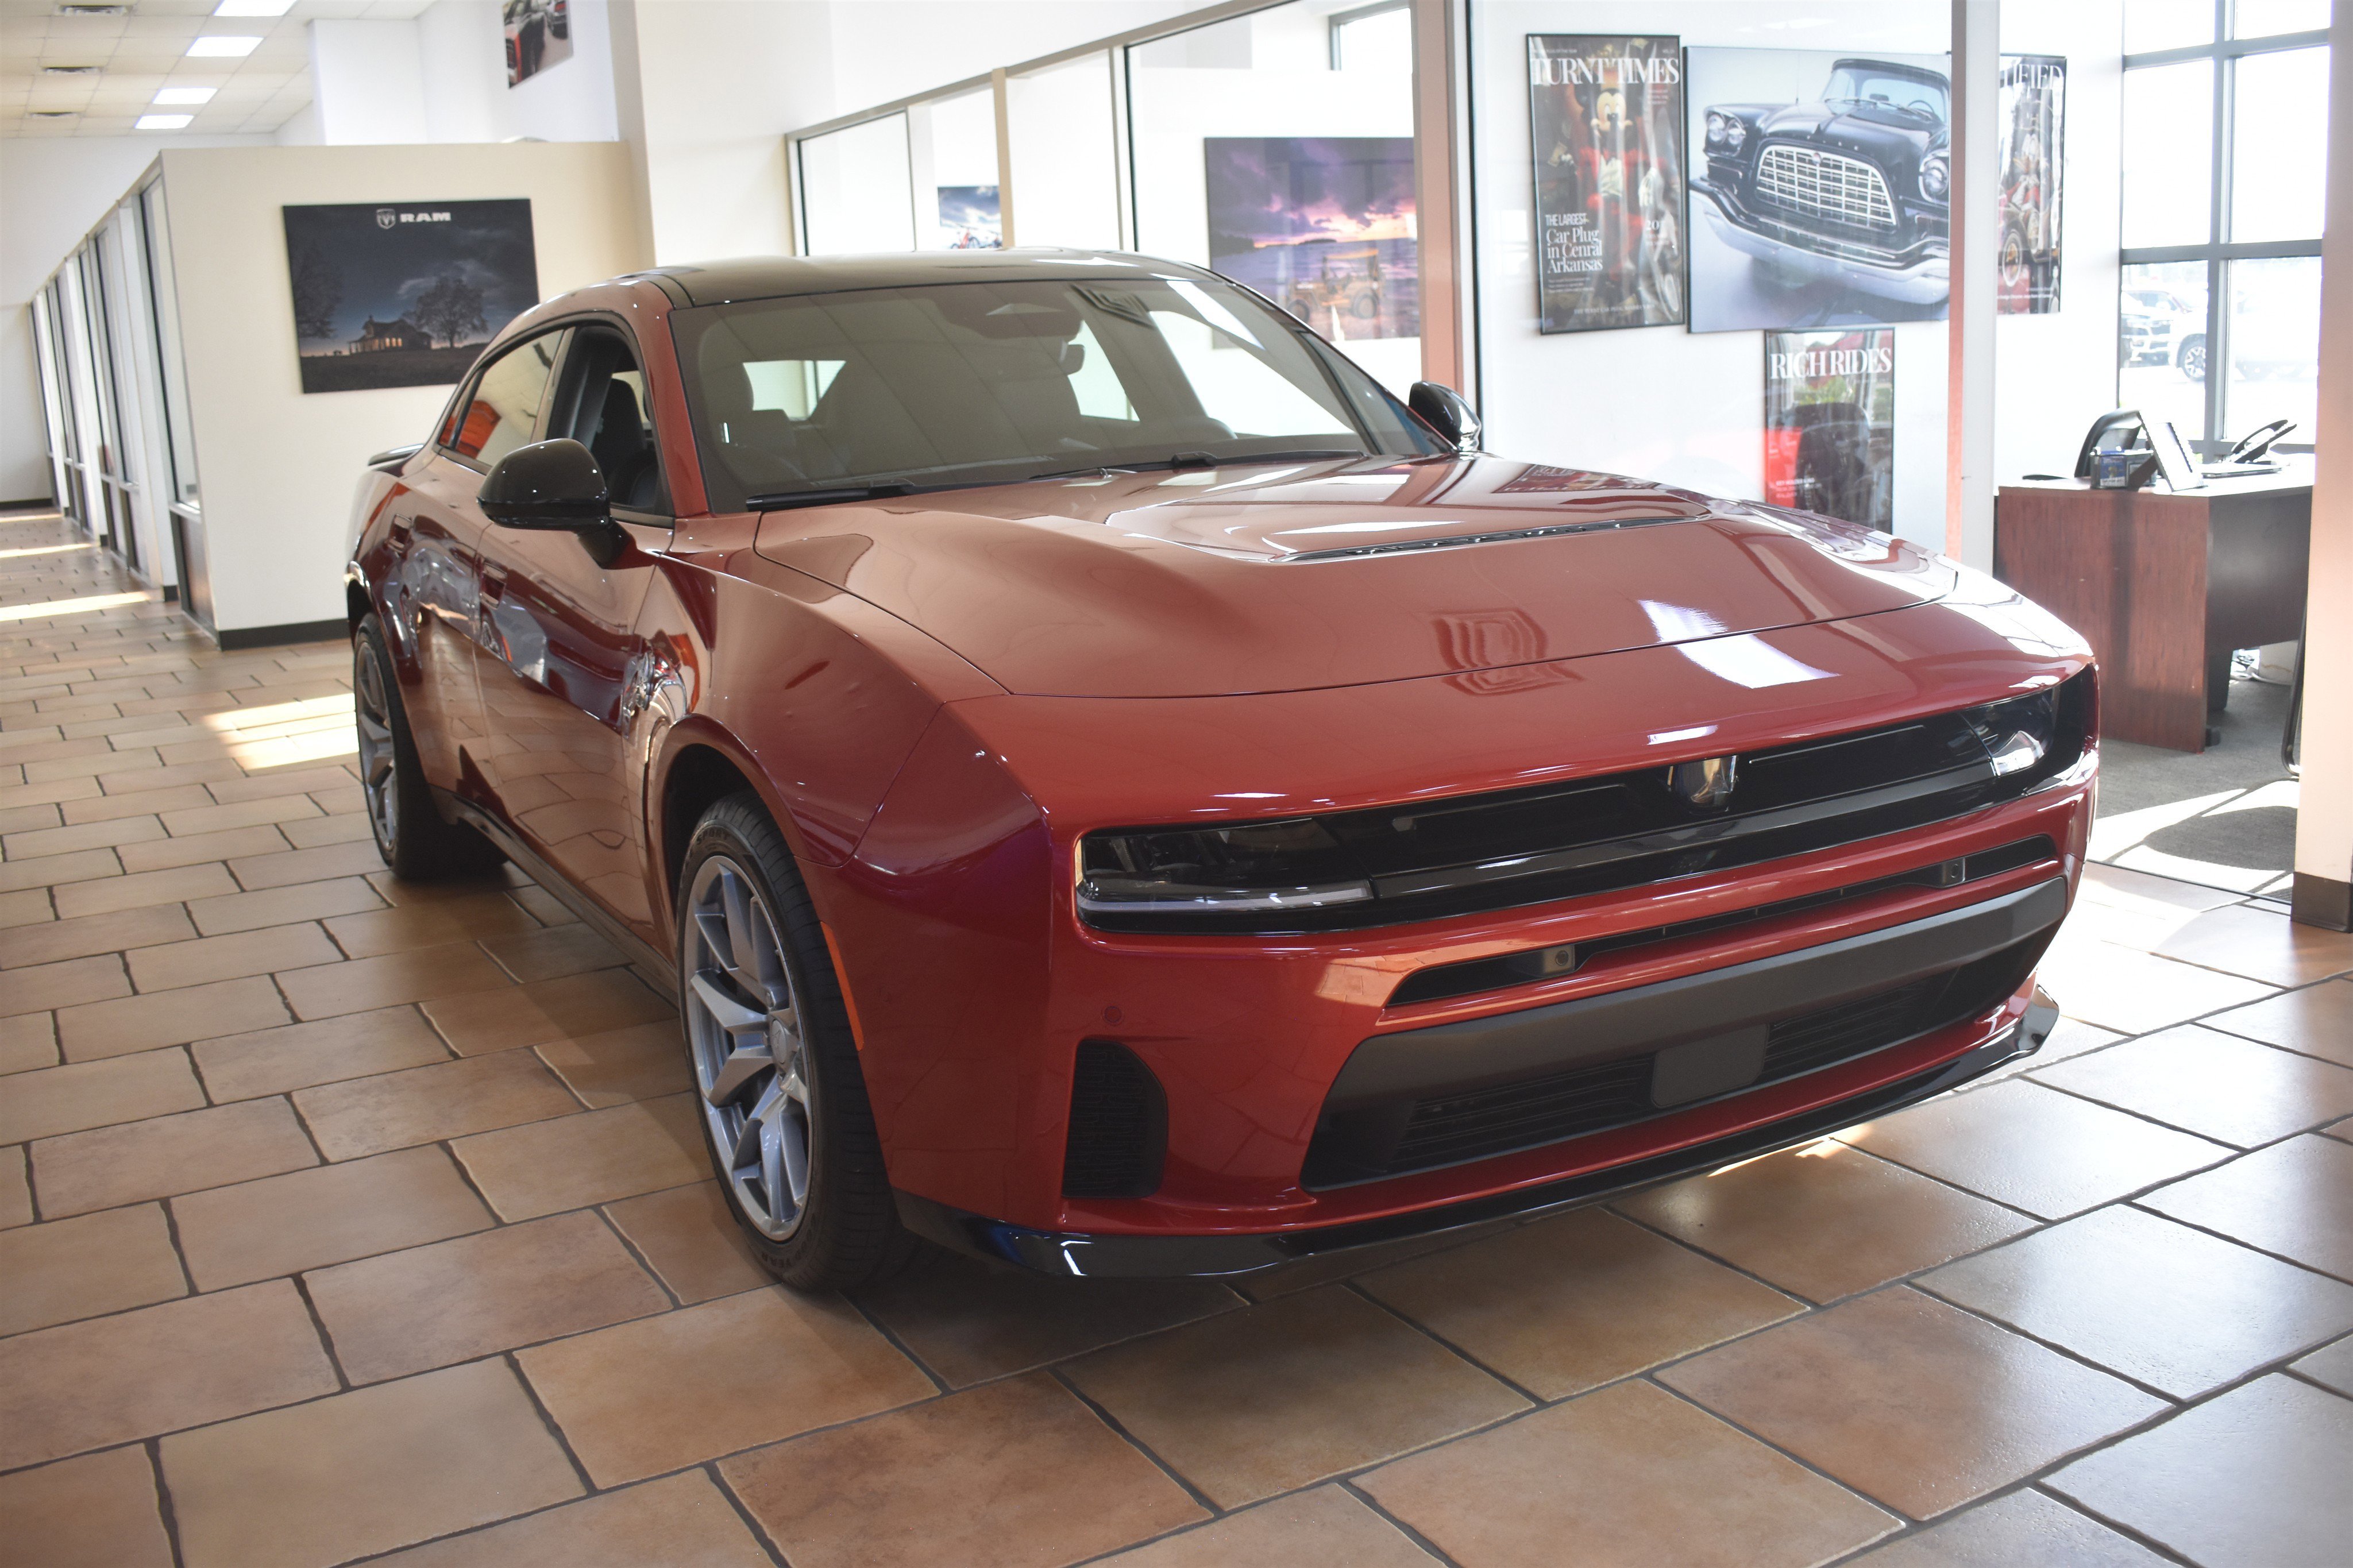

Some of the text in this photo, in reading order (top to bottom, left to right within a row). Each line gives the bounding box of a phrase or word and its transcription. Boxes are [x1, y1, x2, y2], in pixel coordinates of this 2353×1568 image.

[1530, 57, 1680, 84] TURNT TIMES
[400, 212, 451, 223] RAM
[1545, 213, 1587, 226] THE LARGEST
[1546, 226, 1599, 244] Car Plug
[1547, 242, 1560, 259] in
[1547, 257, 1603, 274] Arkansas
[1770, 347, 1893, 380] RICH RIDES
[696, 828, 731, 845] SPORT
